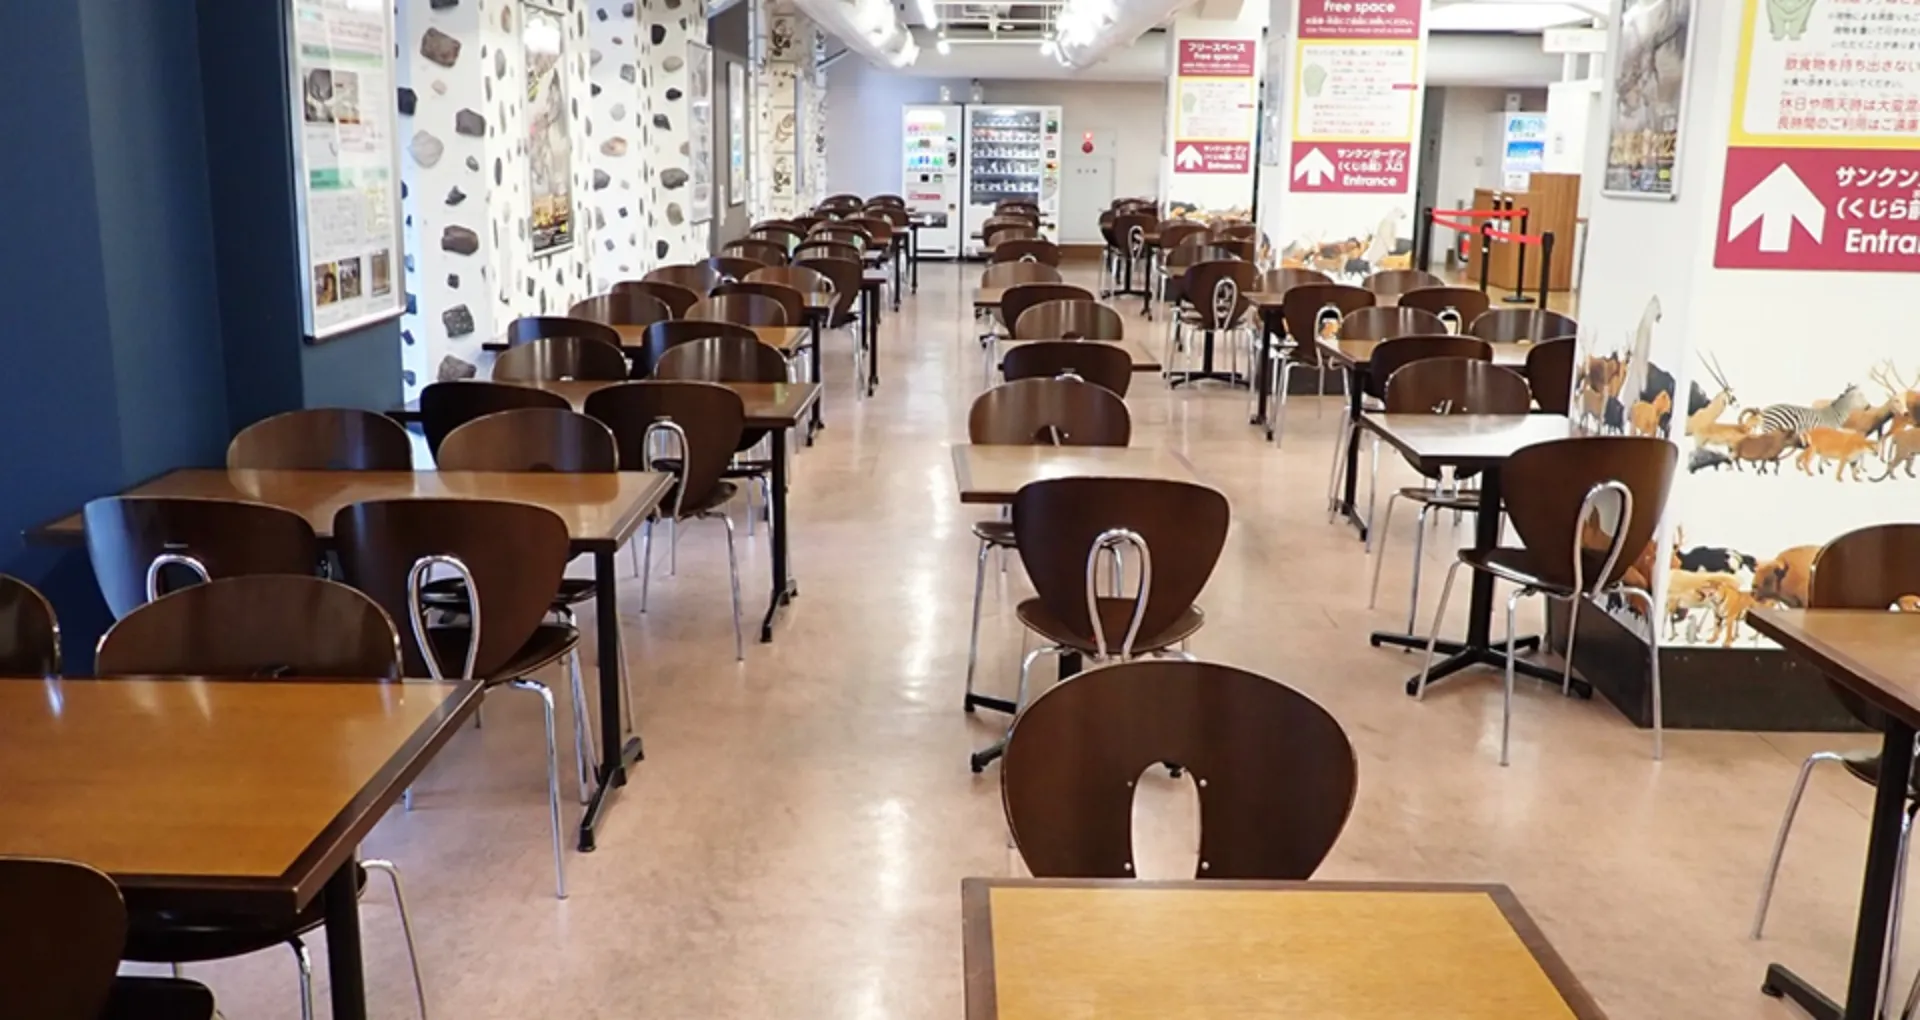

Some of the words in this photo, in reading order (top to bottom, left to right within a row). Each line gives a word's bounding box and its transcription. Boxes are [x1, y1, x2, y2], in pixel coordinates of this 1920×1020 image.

[1324, 0, 1352, 12] free
[1355, 3, 1395, 15] space
[1188, 42, 1246, 53] フリースペース
[1780, 97, 1920, 112] 休日や雨天時は大変混
[1343, 174, 1397, 187] Entrance
[1835, 166, 1920, 189] サンクン
[1844, 228, 1920, 254] Entra
